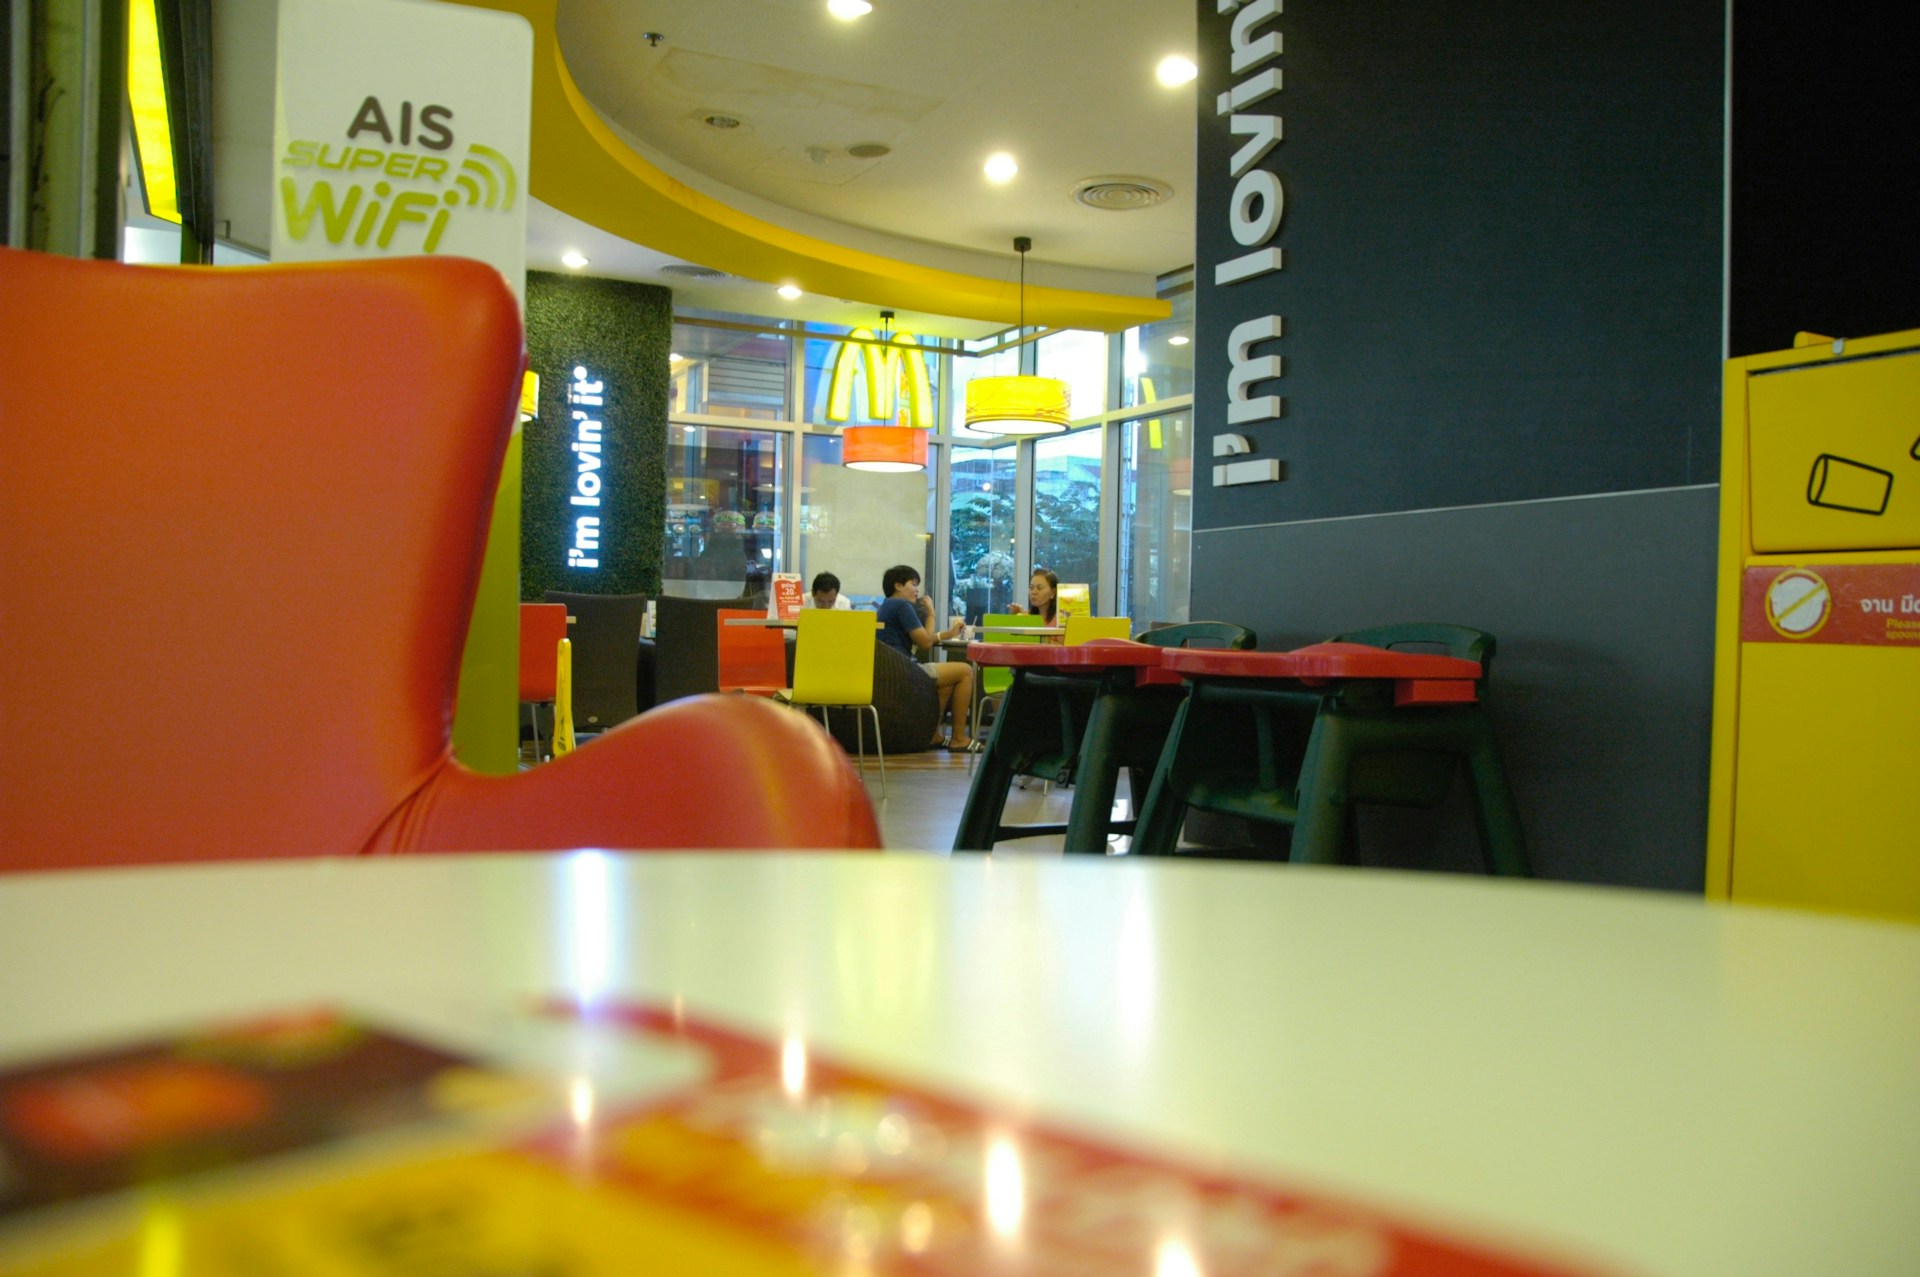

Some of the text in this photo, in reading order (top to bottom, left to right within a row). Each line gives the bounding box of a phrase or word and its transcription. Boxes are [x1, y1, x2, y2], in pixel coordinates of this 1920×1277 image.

[347, 96, 454, 150] AIS
[282, 139, 450, 182] SUPER
[280, 176, 460, 254] WiFi
[1213, 314, 1282, 487] i'm
[570, 410, 602, 507] lovin'
[568, 517, 600, 568] i'm
[1860, 598, 1893, 613] จาน
